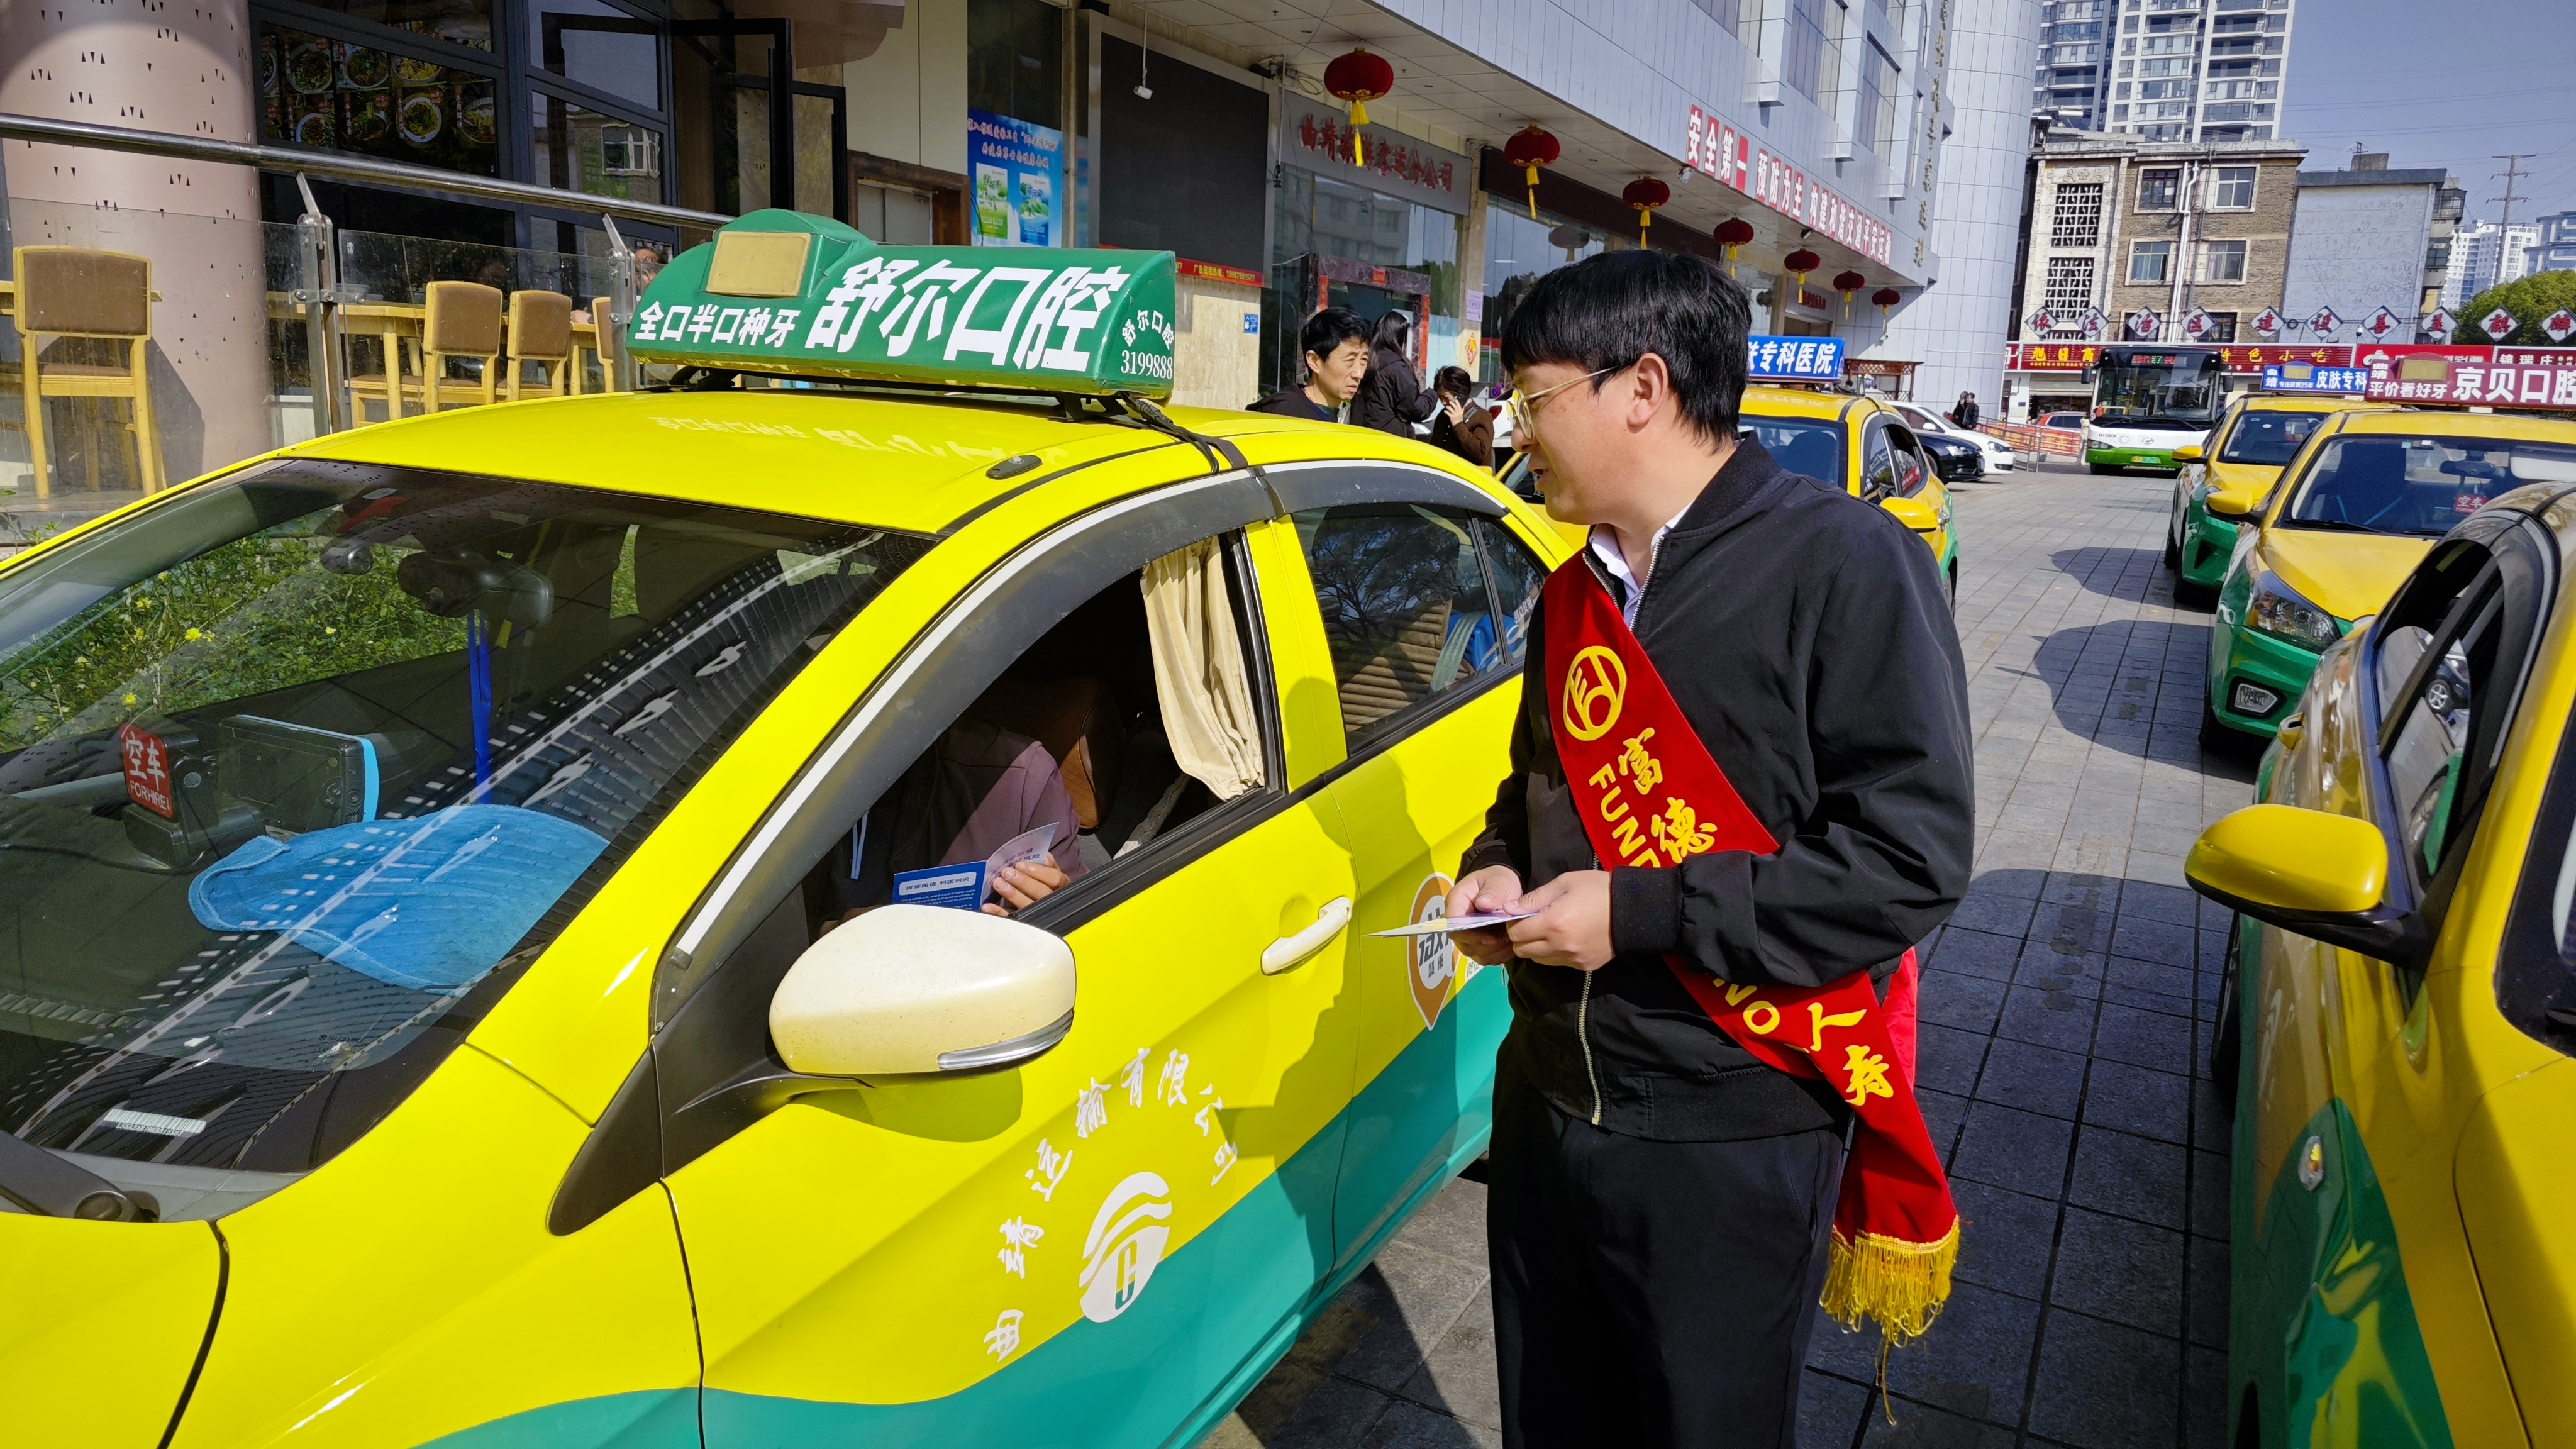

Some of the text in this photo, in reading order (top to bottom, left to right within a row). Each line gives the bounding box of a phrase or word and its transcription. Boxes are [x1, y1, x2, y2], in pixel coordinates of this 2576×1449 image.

[1689, 110, 1892, 265] 安全第一 预防为主 构建和谐交通平安运输
[635, 301, 801, 348] 全口半口种牙
[804, 256, 1131, 371] 舒尔口腔
[1121, 309, 1174, 350] 舒尔口腔
[1121, 350, 1173, 379] 3199888
[2265, 368, 2278, 388] 曲靖
[2316, 370, 2367, 390] 皮肤专科
[2370, 363, 2389, 379] 曲靖
[2368, 381, 2448, 399] 平价看好牙
[2452, 366, 2576, 405] 京贝口腔
[2457, 495, 2485, 508] 空车
[126, 730, 166, 791] 空车
[1618, 727, 1718, 863] 富德
[939, 877, 969, 885] 利国利民
[1807, 1002, 1894, 1106] 人寿
[983, 1047, 1238, 1362] 曲靖运输有限公司
